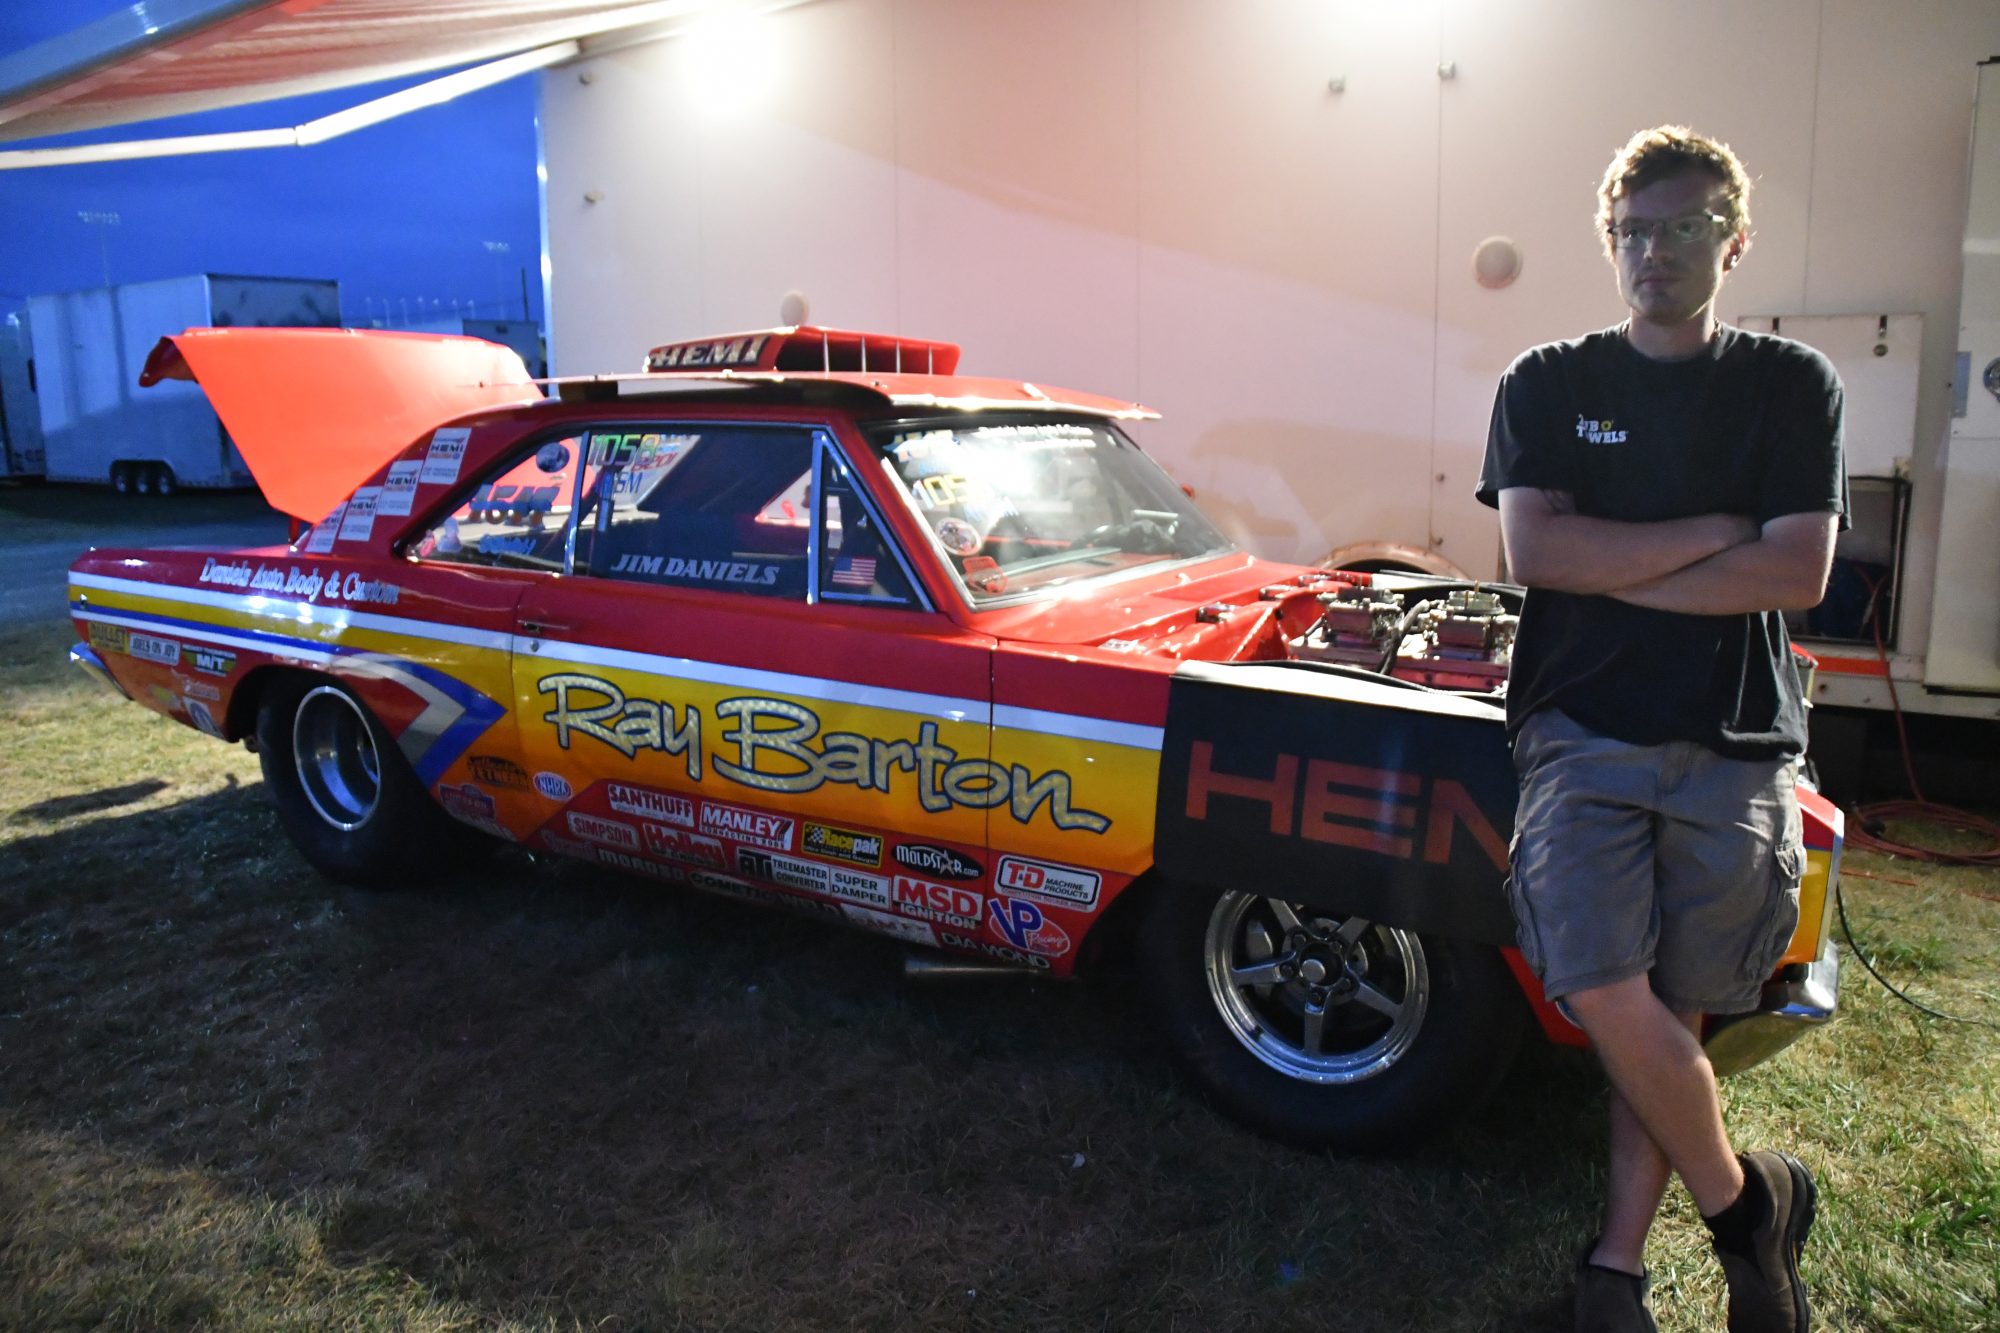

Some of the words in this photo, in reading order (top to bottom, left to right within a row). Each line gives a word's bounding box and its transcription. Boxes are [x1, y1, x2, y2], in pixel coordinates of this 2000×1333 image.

[652, 336, 769, 367] HEMI
[610, 553, 664, 575] JIM
[664, 557, 780, 585] DANIELS
[284, 566, 324, 602] Body
[538, 673, 701, 780] Ray
[712, 696, 1112, 835] Barton
[609, 785, 691, 817] SANTHUFF
[573, 817, 633, 845] SIMPSON
[701, 826, 757, 843] CONNECTING
[703, 806, 781, 837] MANLEY
[773, 858, 828, 879] TREEMASTER
[776, 871, 827, 891] CONVERTER
[834, 872, 878, 890] SUPER
[832, 884, 886, 904] DAMPER
[898, 879, 978, 917] MSD
[1044, 884, 1089, 900] PRODUCTS
[1045, 878, 1085, 891] MACHINE
[900, 903, 976, 929] IGNITION
